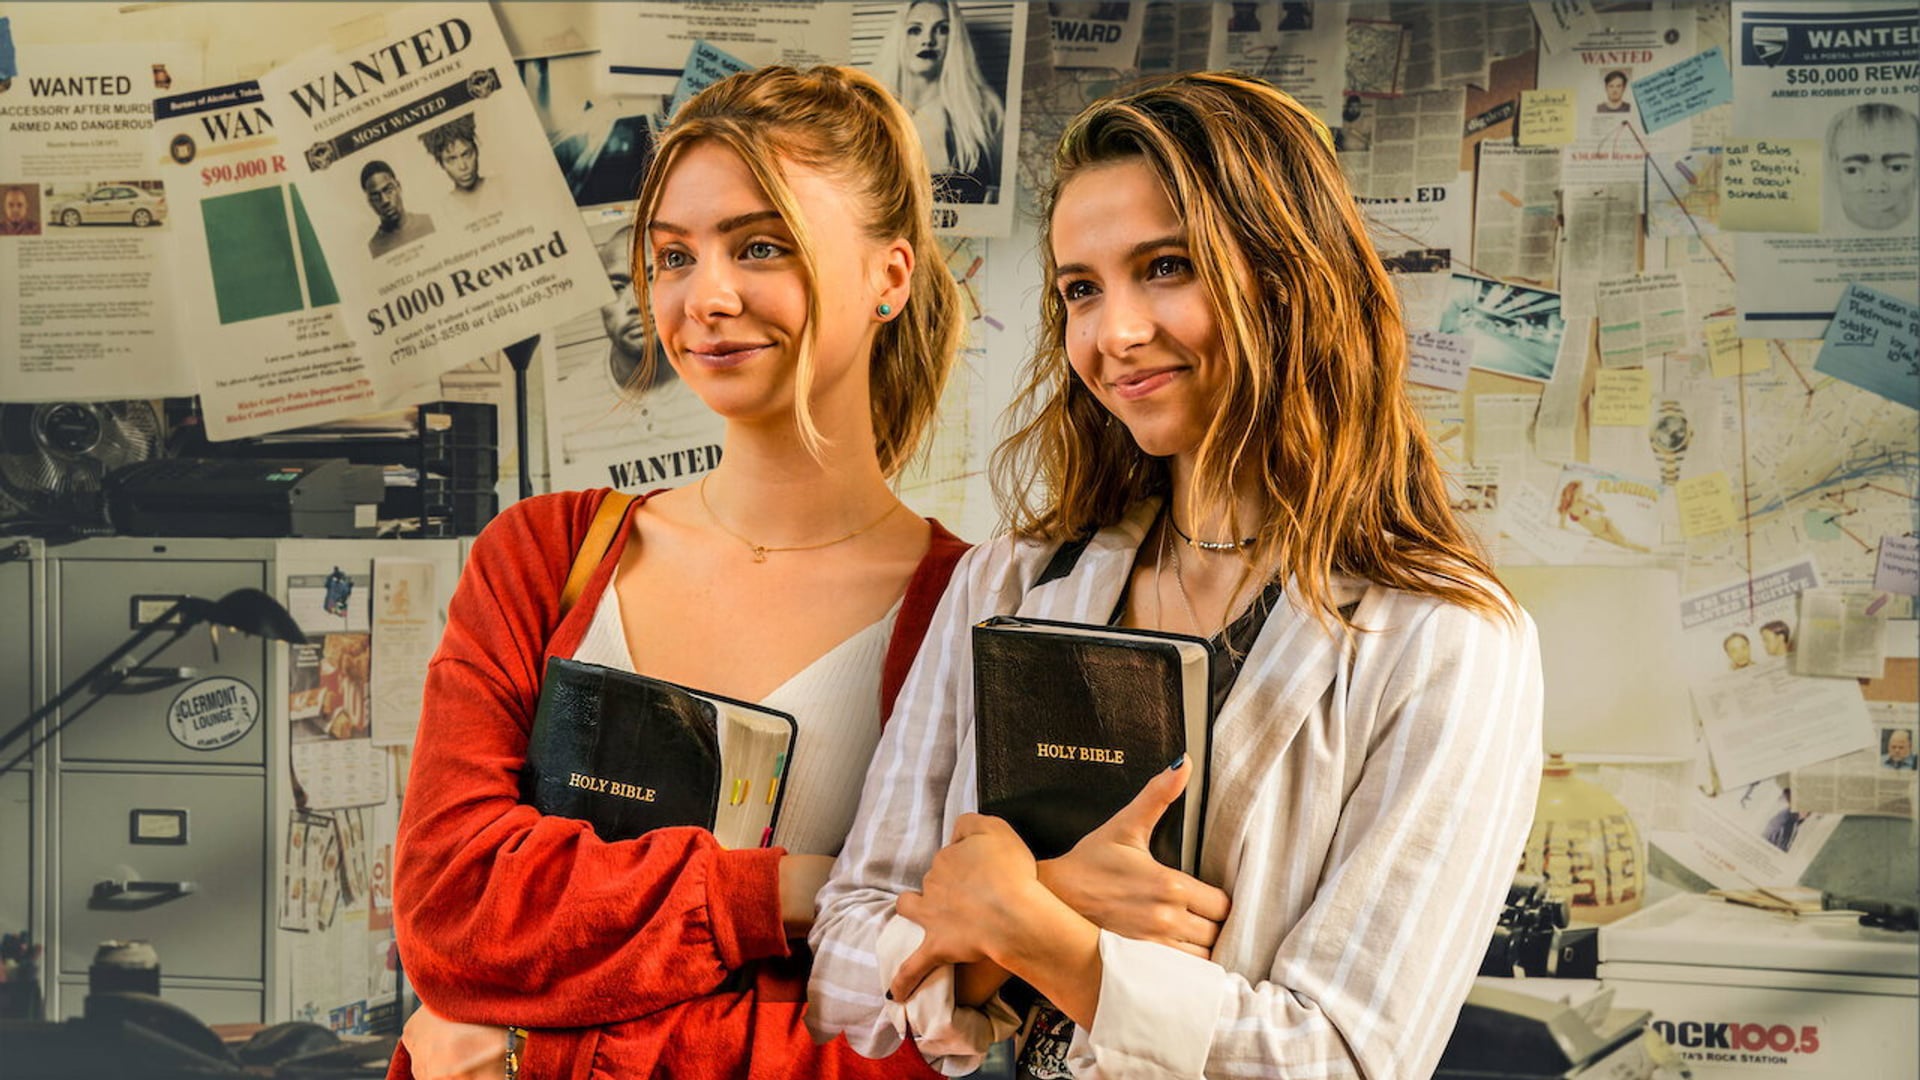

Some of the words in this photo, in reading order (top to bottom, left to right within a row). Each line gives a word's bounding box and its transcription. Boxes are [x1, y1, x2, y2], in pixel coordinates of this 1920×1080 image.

[1581, 50, 1653, 64] WANTED
[1820, 52, 1850, 60] POSTAL
[1853, 50, 1900, 58] INSPECTION
[289, 18, 472, 119] WANTED
[1786, 67, 1858, 84] $50,000
[29, 75, 132, 97] WANTED
[1771, 89, 1808, 98] ARMED
[1811, 88, 1861, 97] ROBBERY
[1864, 86, 1877, 96] OF
[1, 104, 71, 117] ACCESSORY
[73, 104, 111, 116] AFTER
[346, 95, 382, 118] COUNTY
[10, 121, 50, 132] ARMED
[54, 121, 77, 131] AND
[81, 119, 153, 131] DANGEROUS
[201, 107, 274, 142] WAN
[351, 123, 389, 146] MOST
[390, 96, 447, 128] WANTED
[1726, 144, 1749, 154] call
[201, 157, 268, 187] $90,000
[272, 155, 287, 174] R
[1728, 157, 1742, 166] at
[1724, 176, 1743, 186] see
[1752, 177, 1791, 187] about
[416, 262, 444, 279] Armed
[443, 248, 479, 268] Robbery
[480, 239, 497, 254] and
[496, 224, 536, 247] Shooting
[367, 280, 446, 336] $1000
[449, 230, 569, 299] Reward
[394, 327, 424, 346] Contact
[425, 322, 438, 333] the
[438, 310, 465, 327] Fulton
[465, 299, 495, 316] County
[495, 281, 531, 302] Sheriff's
[531, 273, 557, 288] Office
[1851, 286, 1875, 303] Last
[1879, 300, 1907, 315] seen
[472, 316, 486, 329] or
[248, 408, 275, 420] County
[276, 398, 338, 414] Communications
[259, 394, 286, 406] County
[288, 390, 309, 401] Police
[608, 444, 723, 489] WANTED
[180, 685, 238, 719] CLERMONT
[193, 708, 234, 730] LOUNGE
[1037, 743, 1077, 759] HOLY
[1079, 747, 1125, 764] BIBLE
[569, 773, 609, 792] HOLY
[610, 781, 656, 802] BIBLE
[1706, 1052, 1738, 1062] ROCK
[1740, 1054, 1788, 1065] STATION
